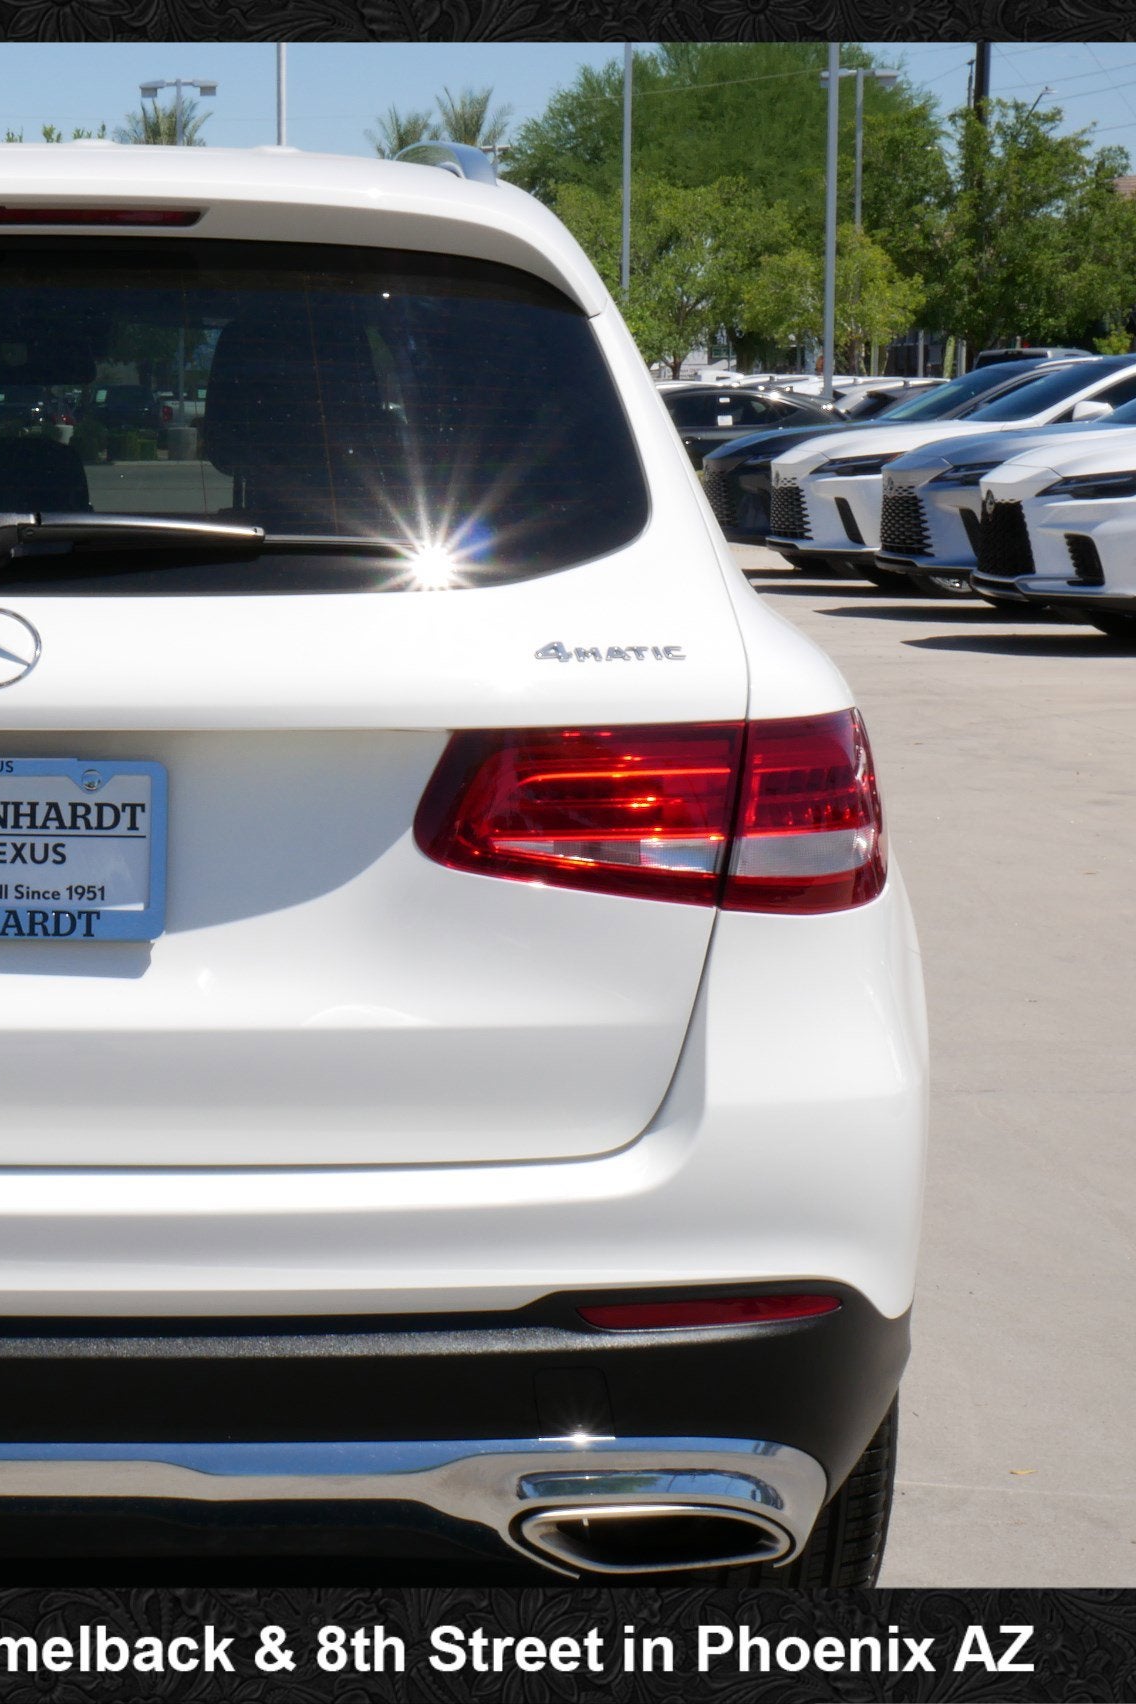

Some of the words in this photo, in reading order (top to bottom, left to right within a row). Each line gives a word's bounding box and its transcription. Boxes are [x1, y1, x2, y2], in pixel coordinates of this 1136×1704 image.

[535, 641, 686, 662] 4MATIC
[14, 885, 61, 901] Since
[65, 885, 106, 902] 1951
